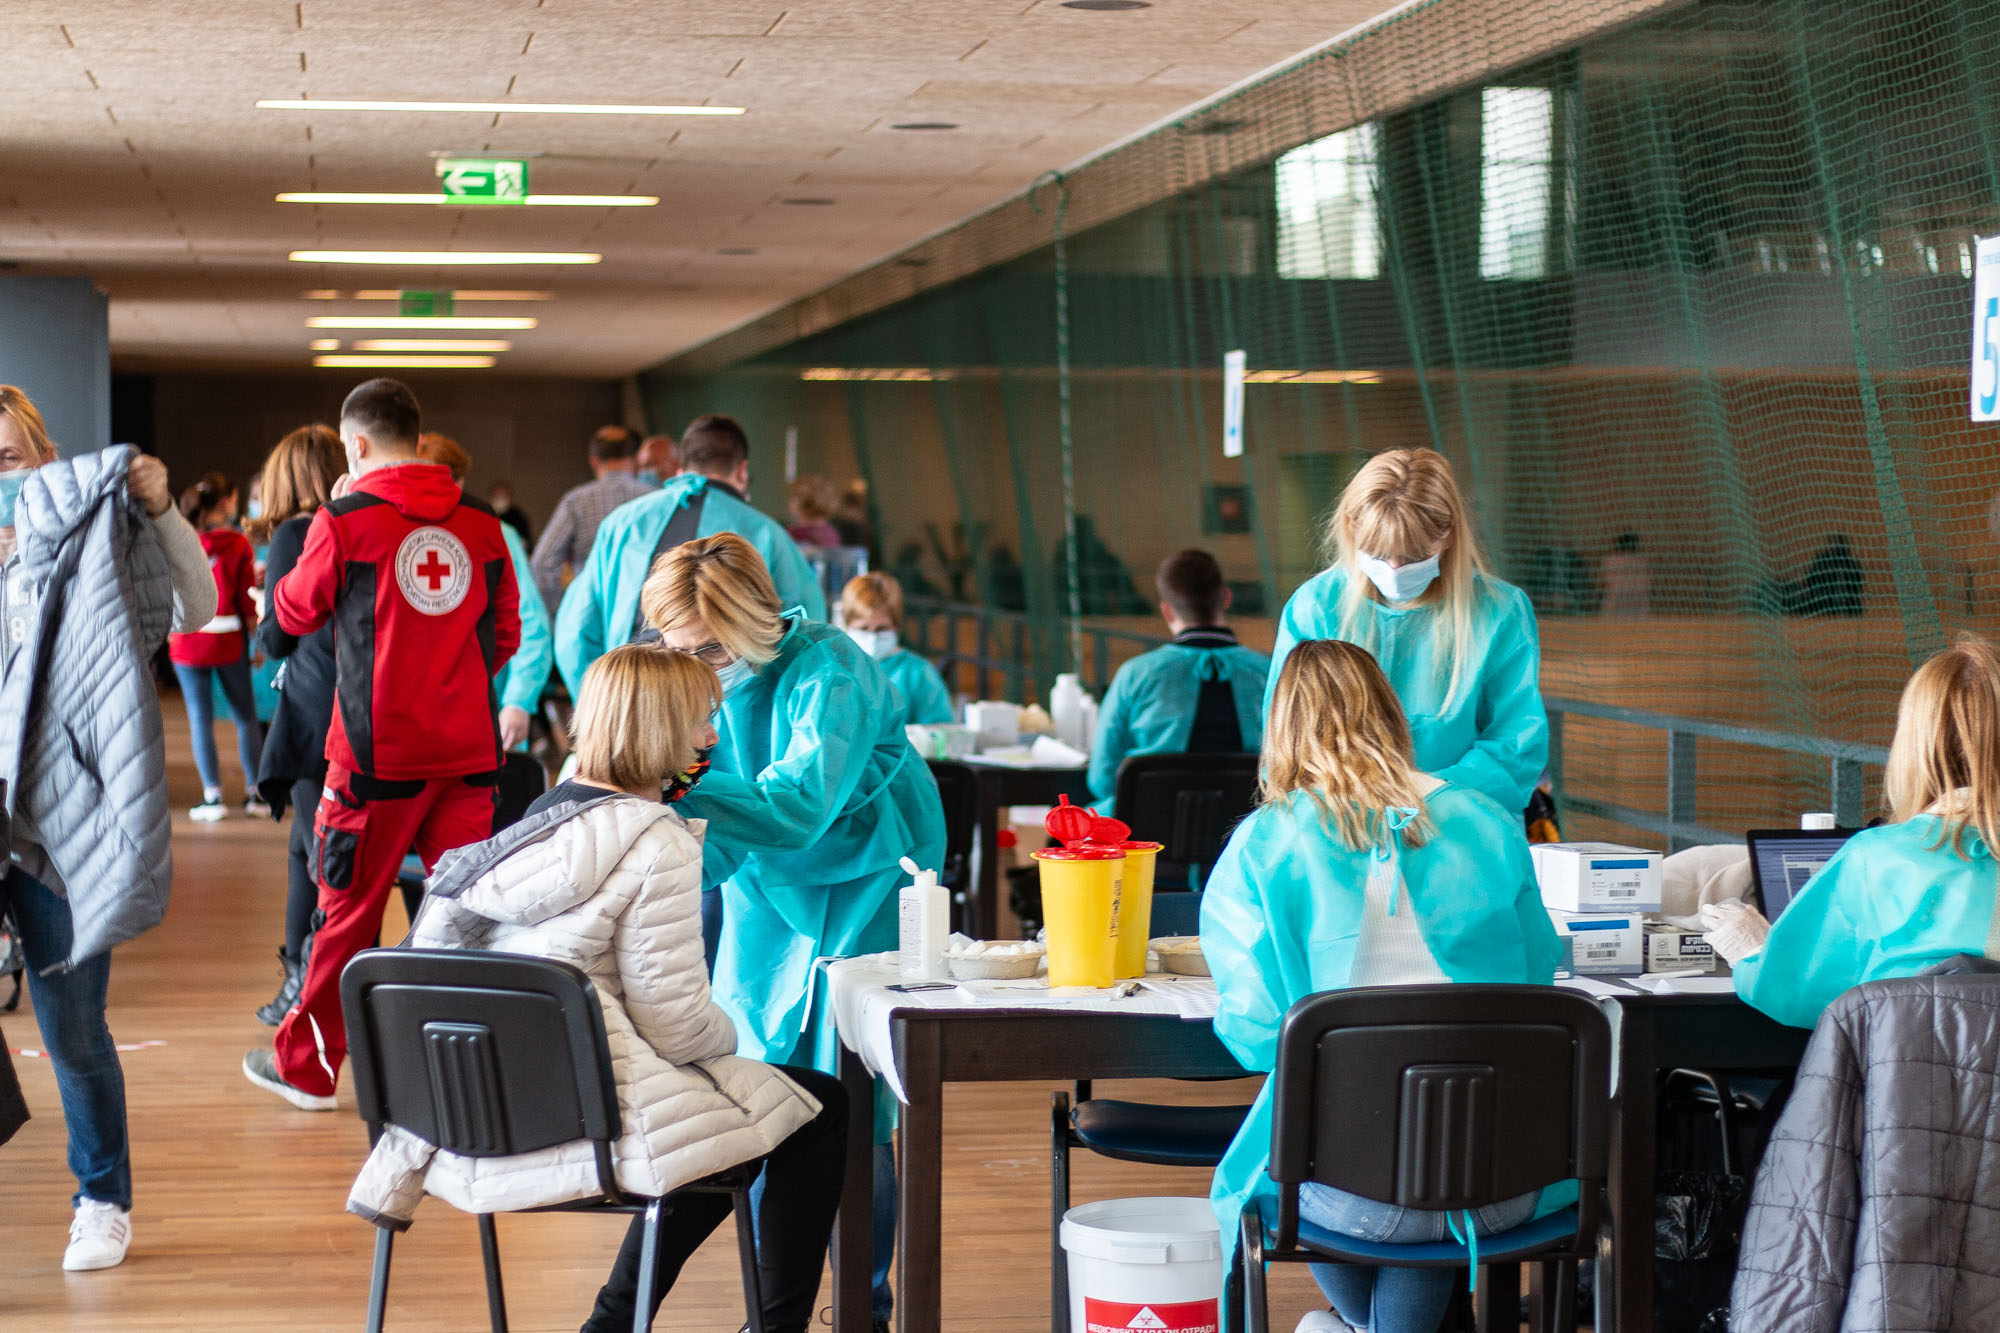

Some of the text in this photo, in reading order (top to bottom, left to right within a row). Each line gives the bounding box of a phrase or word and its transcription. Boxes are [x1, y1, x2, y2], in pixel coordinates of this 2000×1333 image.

[1981, 297, 1999, 415] 5
[431, 599, 450, 608] RED
[449, 574, 467, 601] CROSS
